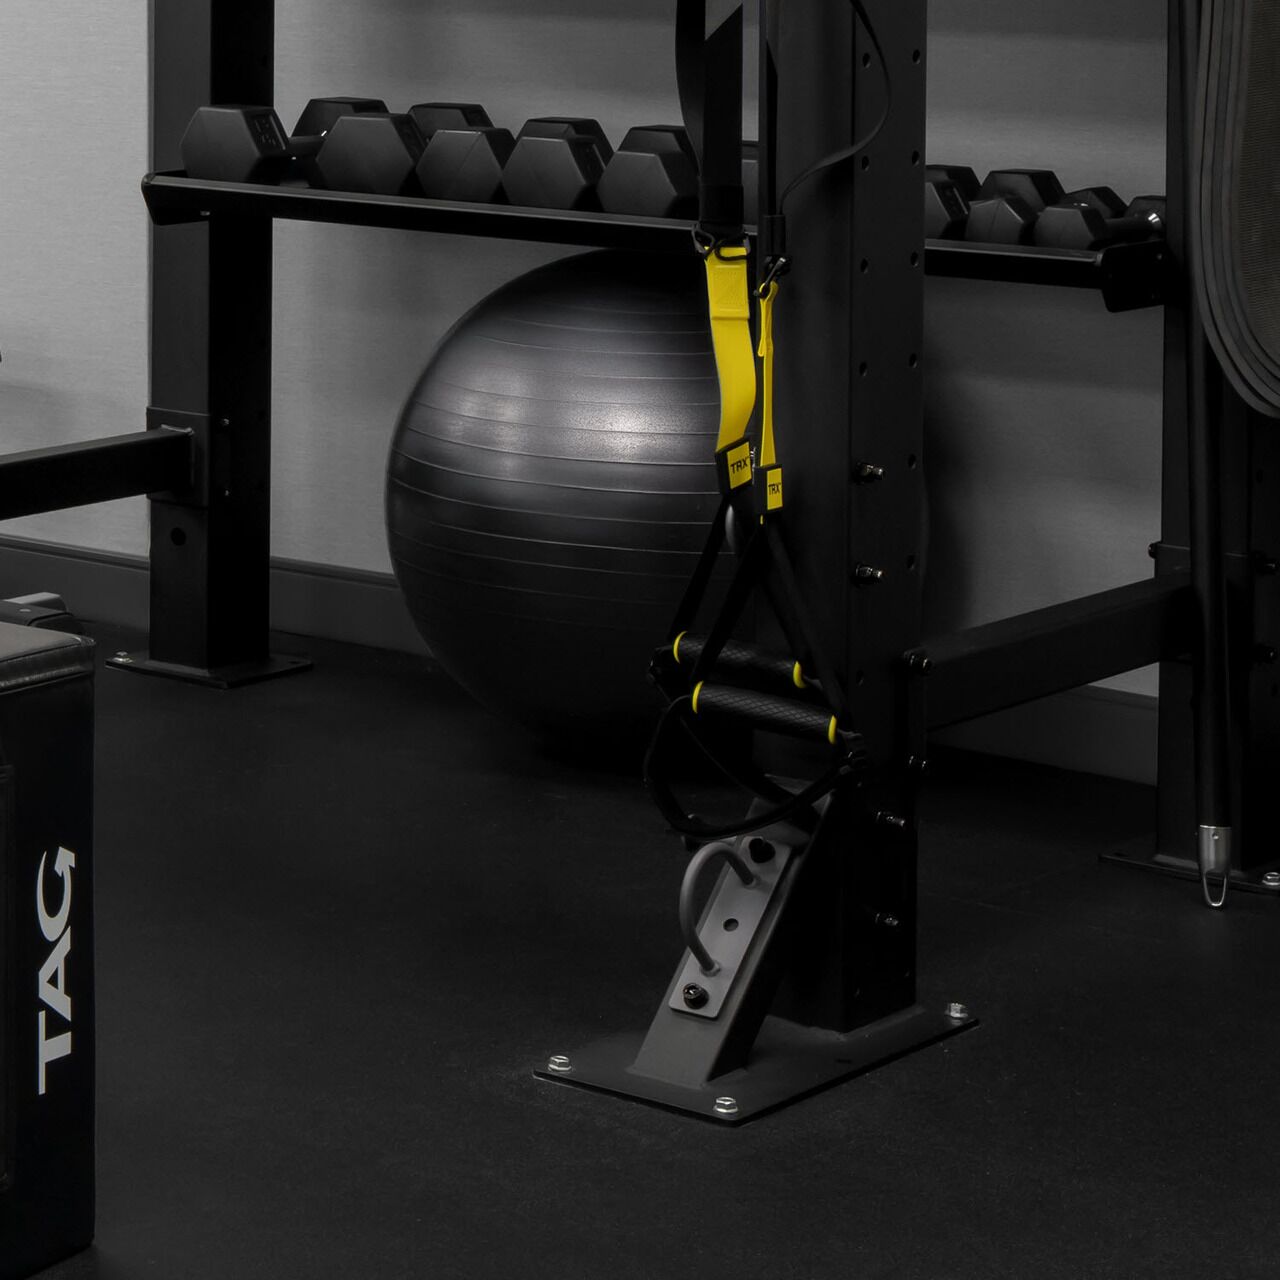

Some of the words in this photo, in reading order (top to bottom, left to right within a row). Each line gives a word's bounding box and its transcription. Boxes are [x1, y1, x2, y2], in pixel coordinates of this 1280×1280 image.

[730, 457, 748, 474] TRX
[768, 483, 781, 496] TRX
[36, 846, 76, 1095] TAG
